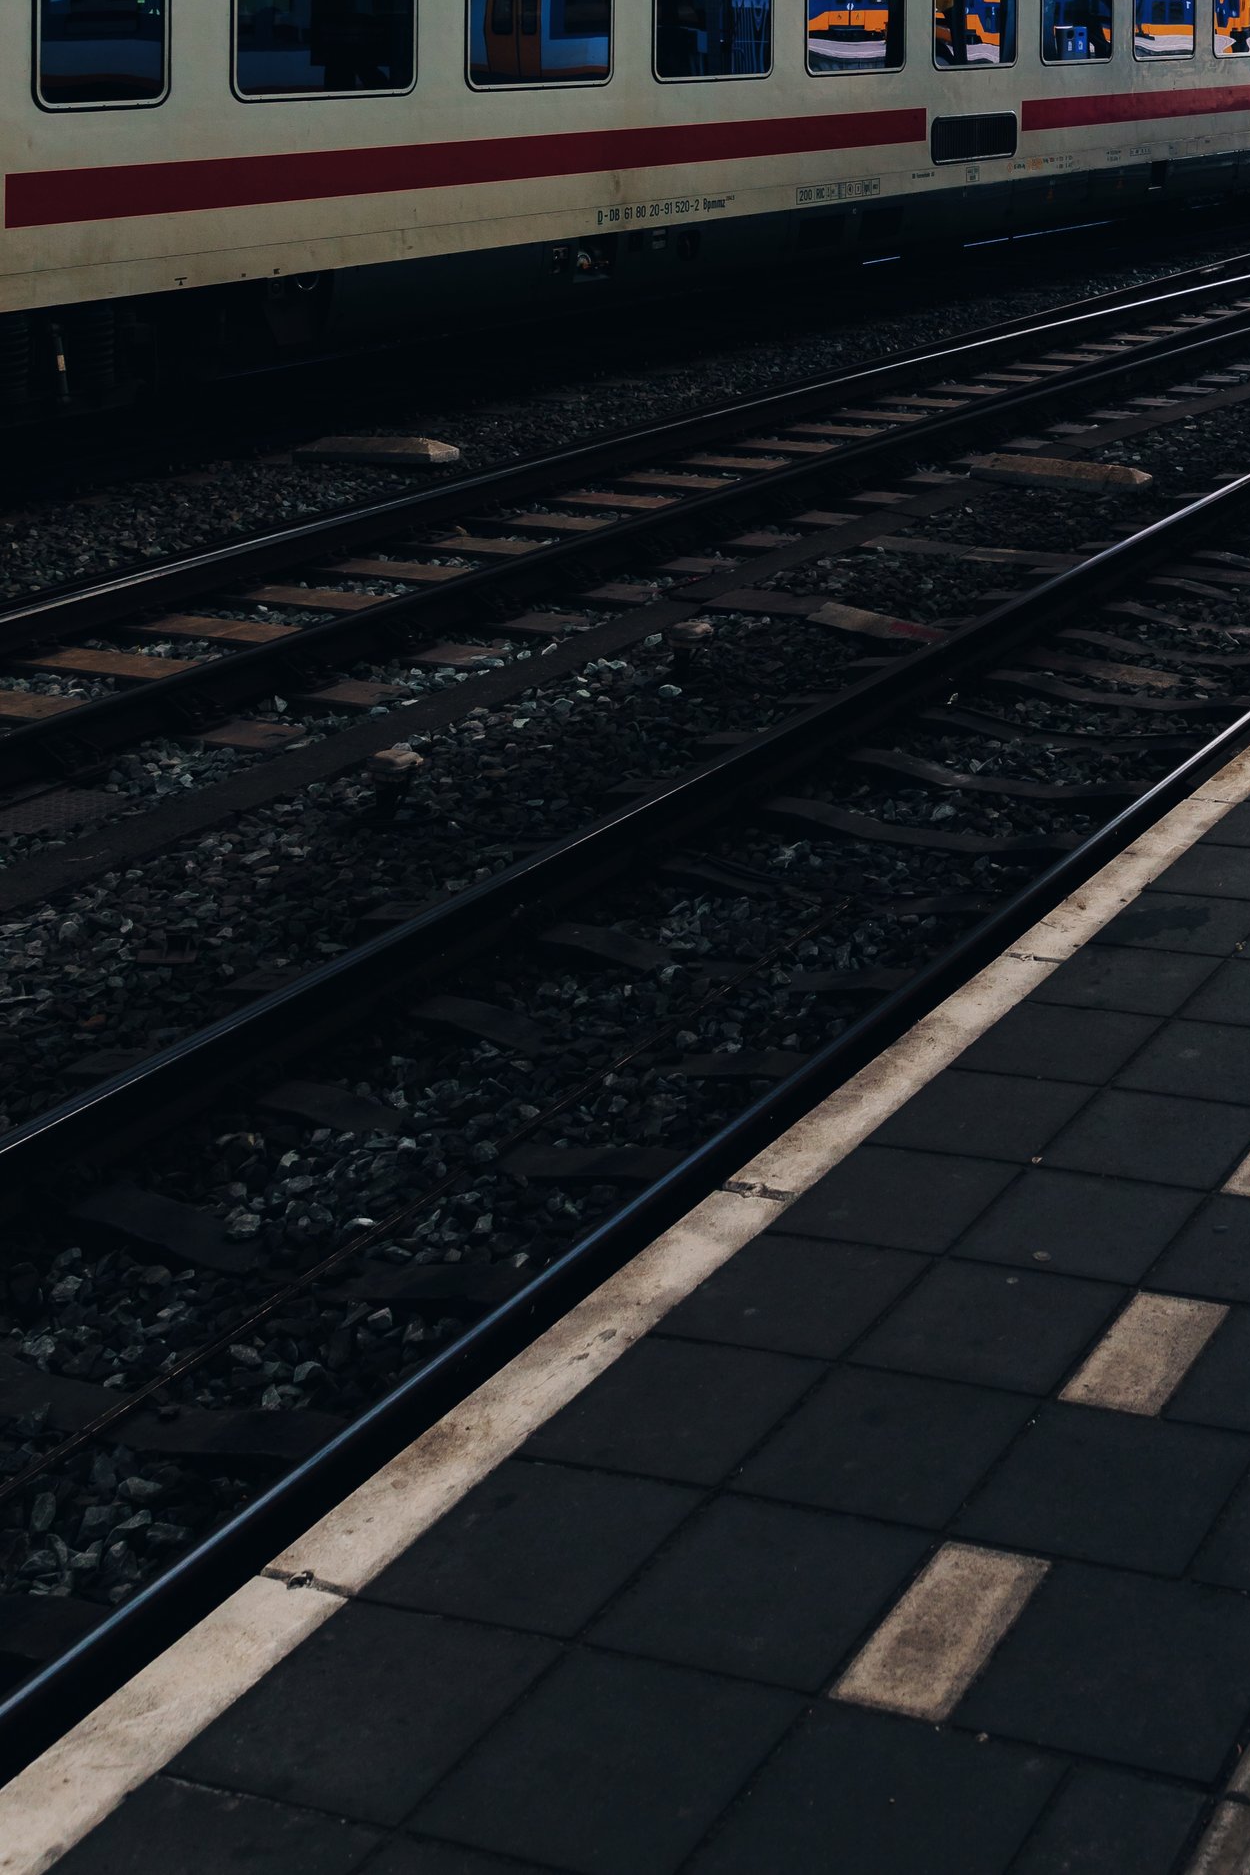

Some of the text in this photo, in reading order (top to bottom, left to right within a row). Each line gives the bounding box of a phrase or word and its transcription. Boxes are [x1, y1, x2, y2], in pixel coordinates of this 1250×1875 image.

[799, 189, 813, 202] 200
[624, 207, 633, 220] 61
[636, 205, 646, 218] 80
[649, 202, 673, 216] 20-91
[675, 199, 700, 213] 520-2
